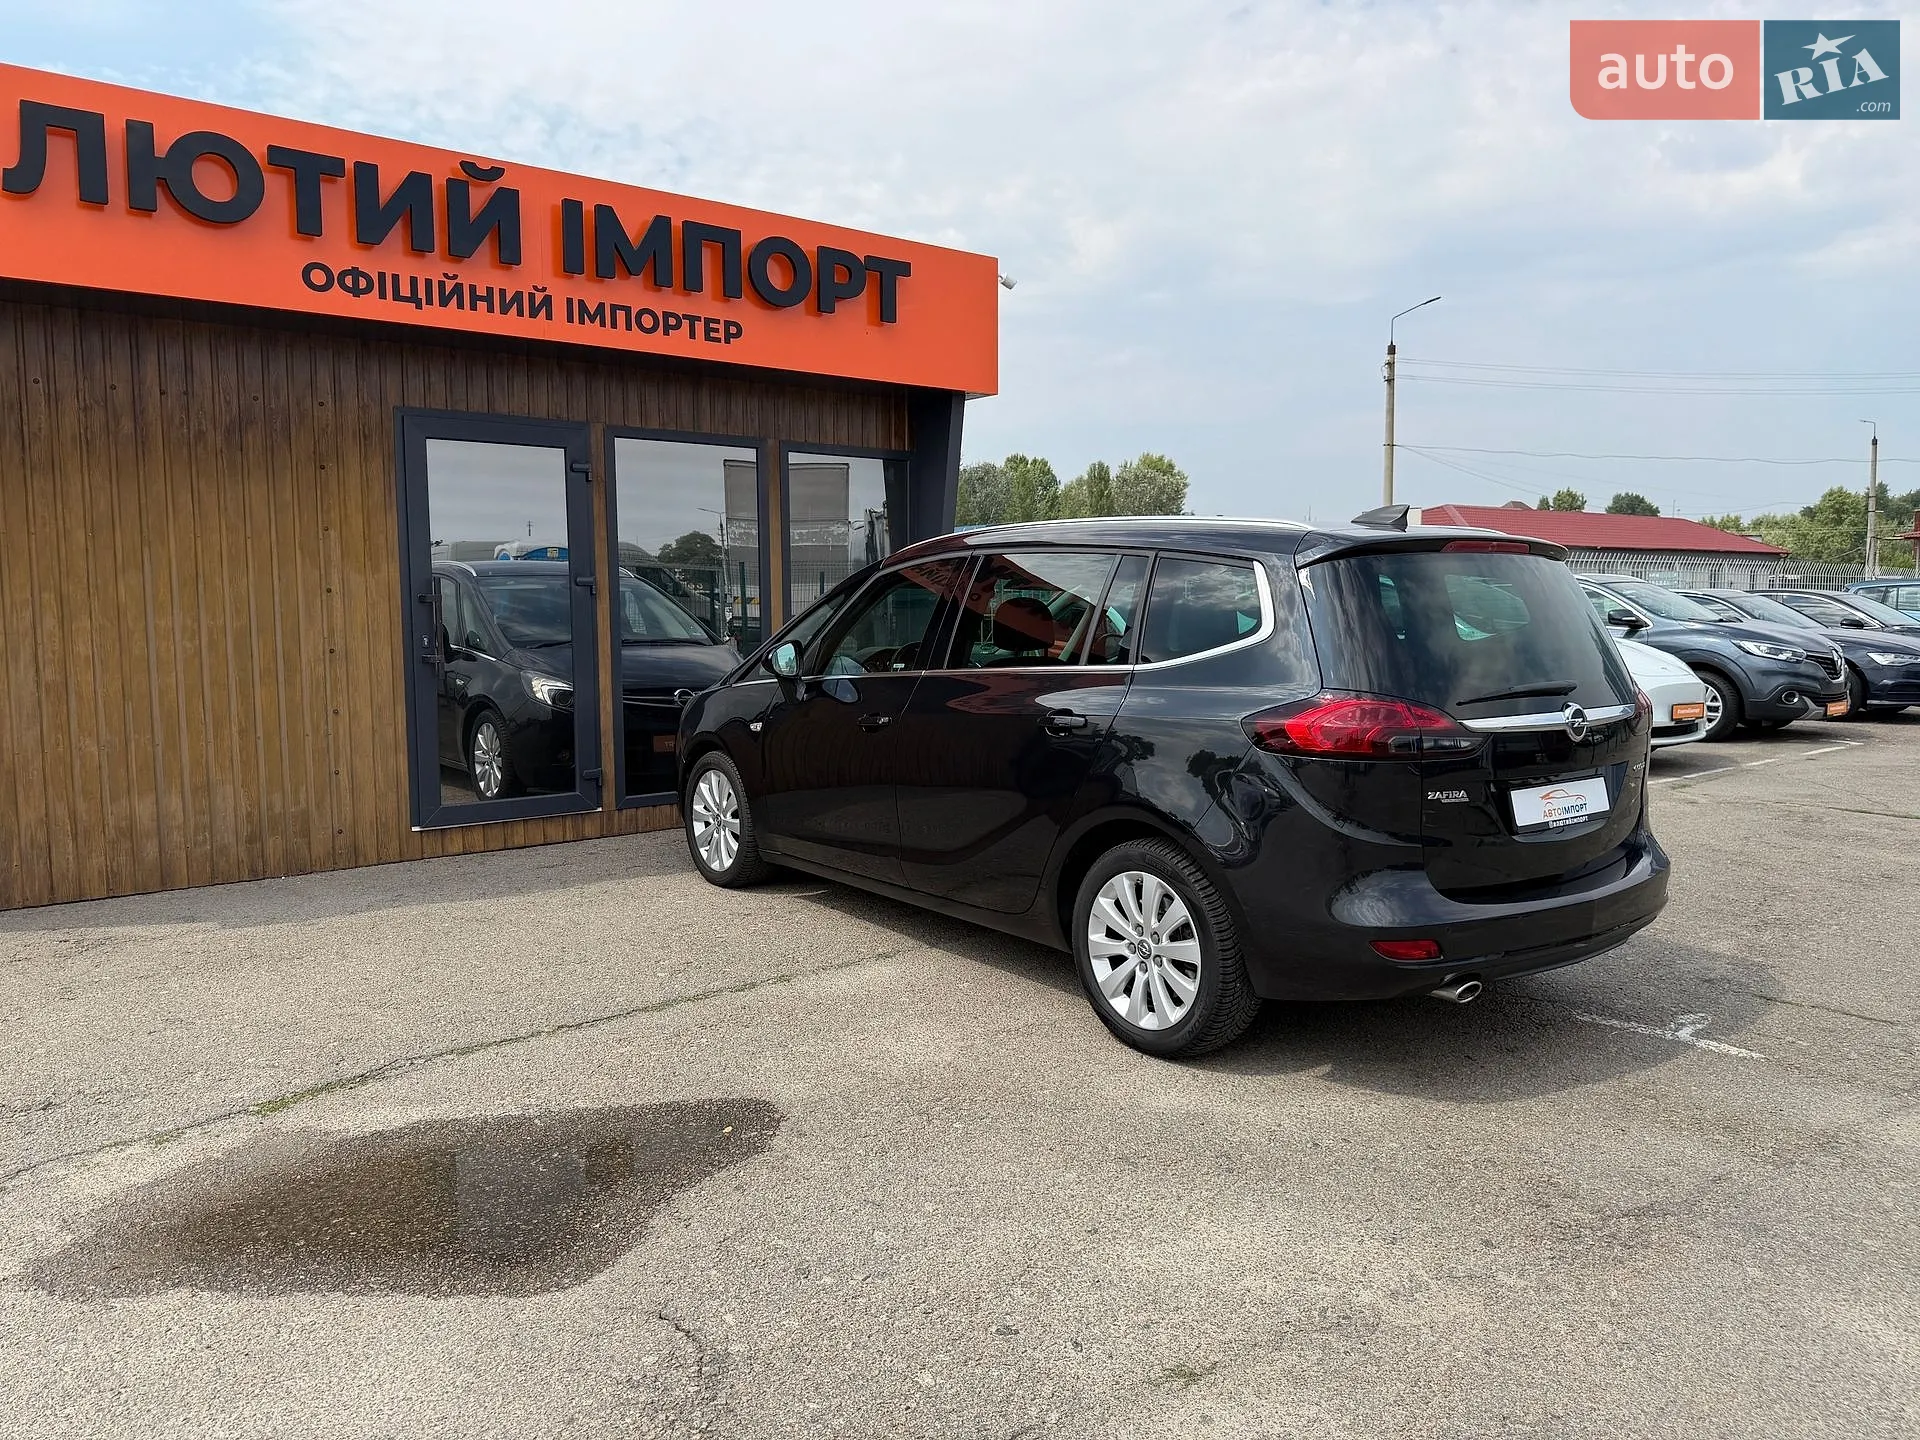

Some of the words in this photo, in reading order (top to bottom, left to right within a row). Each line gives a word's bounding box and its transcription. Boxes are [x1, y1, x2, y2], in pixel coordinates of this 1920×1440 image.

[2, 99, 522, 266] ЛЮТИЙ
[561, 198, 911, 324] ІМПОРТ
[302, 262, 553, 321] ОФІЦІЙНИЙ
[566, 296, 743, 345] ІМПОРТЕР
[1427, 789, 1468, 800] ZAFIRA
